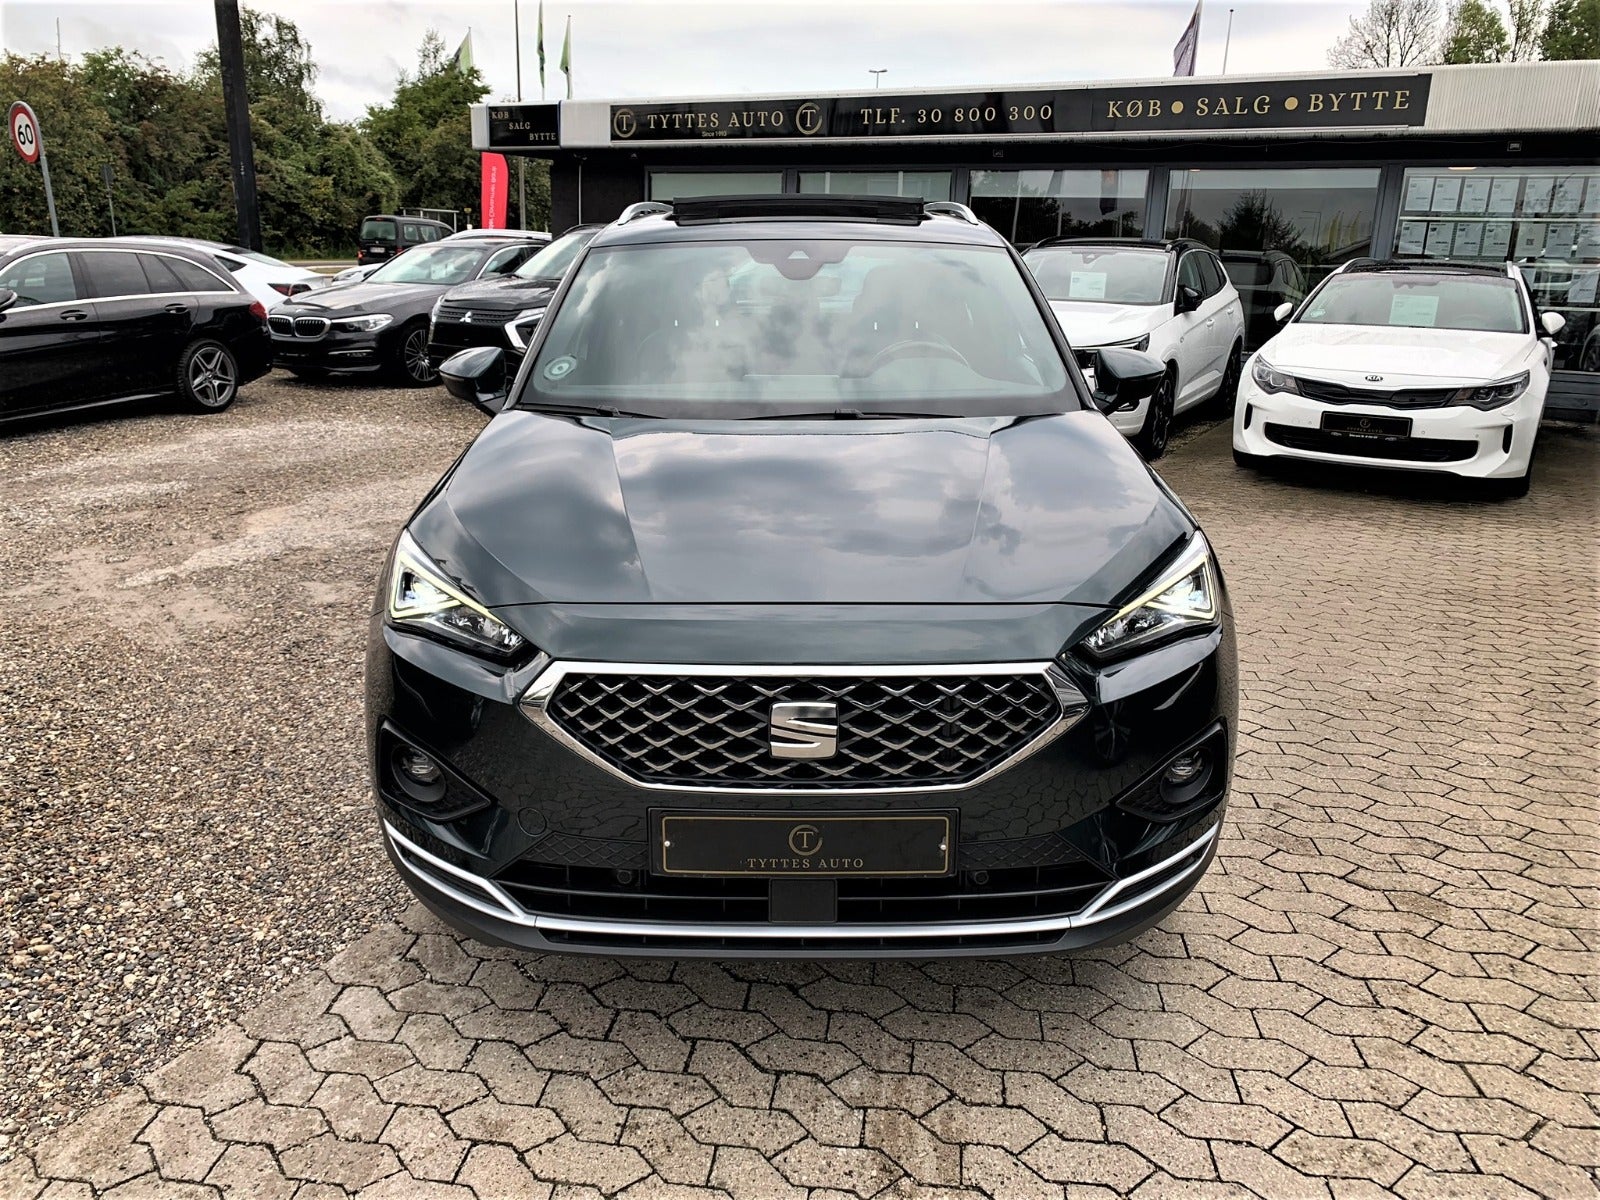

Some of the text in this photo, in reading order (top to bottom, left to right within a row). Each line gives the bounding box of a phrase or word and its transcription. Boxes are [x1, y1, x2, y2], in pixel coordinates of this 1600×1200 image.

[1106, 90, 1411, 119] KØB SALG BYTTE
[491, 111, 509, 120] KØB
[648, 110, 784, 129] TYTTES AUTO
[861, 105, 1053, 125] TLF. 30 800 300
[508, 121, 531, 130] SALG
[18, 123, 33, 145] 60
[529, 132, 557, 141] BYTTE
[746, 857, 865, 869] TYTTES AUTO
